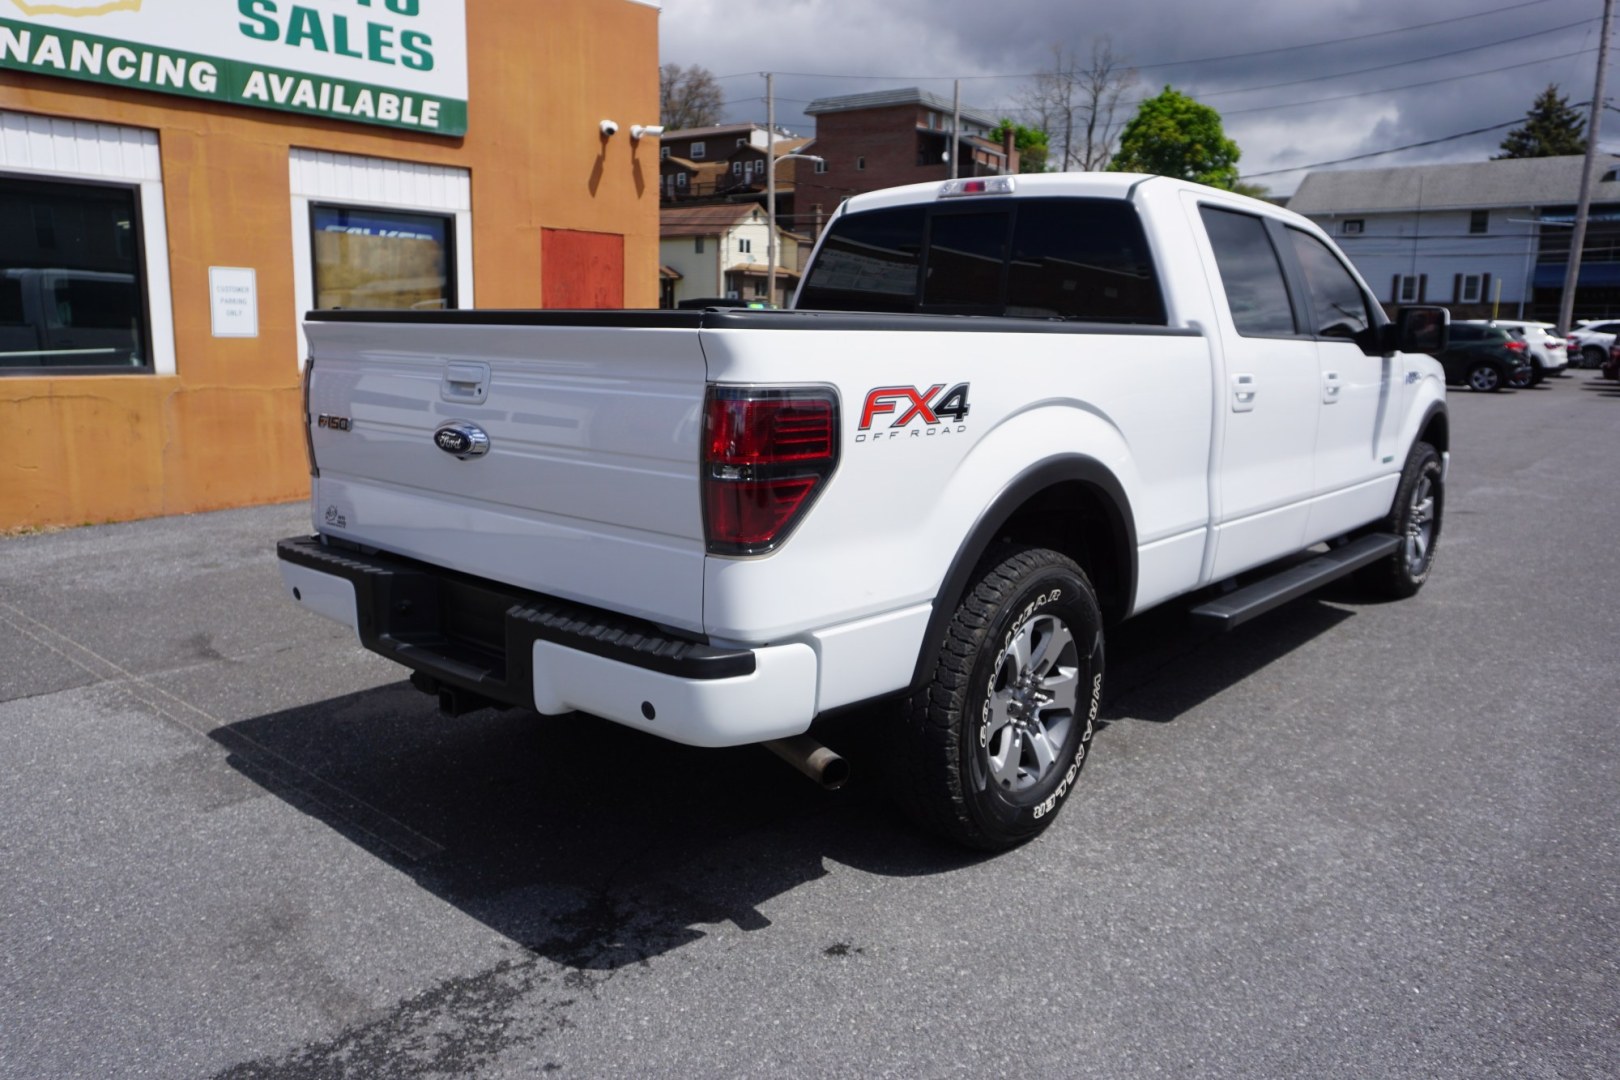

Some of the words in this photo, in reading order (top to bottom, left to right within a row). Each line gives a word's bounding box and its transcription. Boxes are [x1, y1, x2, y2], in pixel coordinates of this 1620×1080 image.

[238, 0, 434, 71] SALES
[242, 71, 440, 128] AVAILABLE
[857, 382, 971, 431] FX4
[439, 431, 461, 449] Ford
[855, 431, 899, 443] OFF
[910, 424, 967, 438] ROAD
